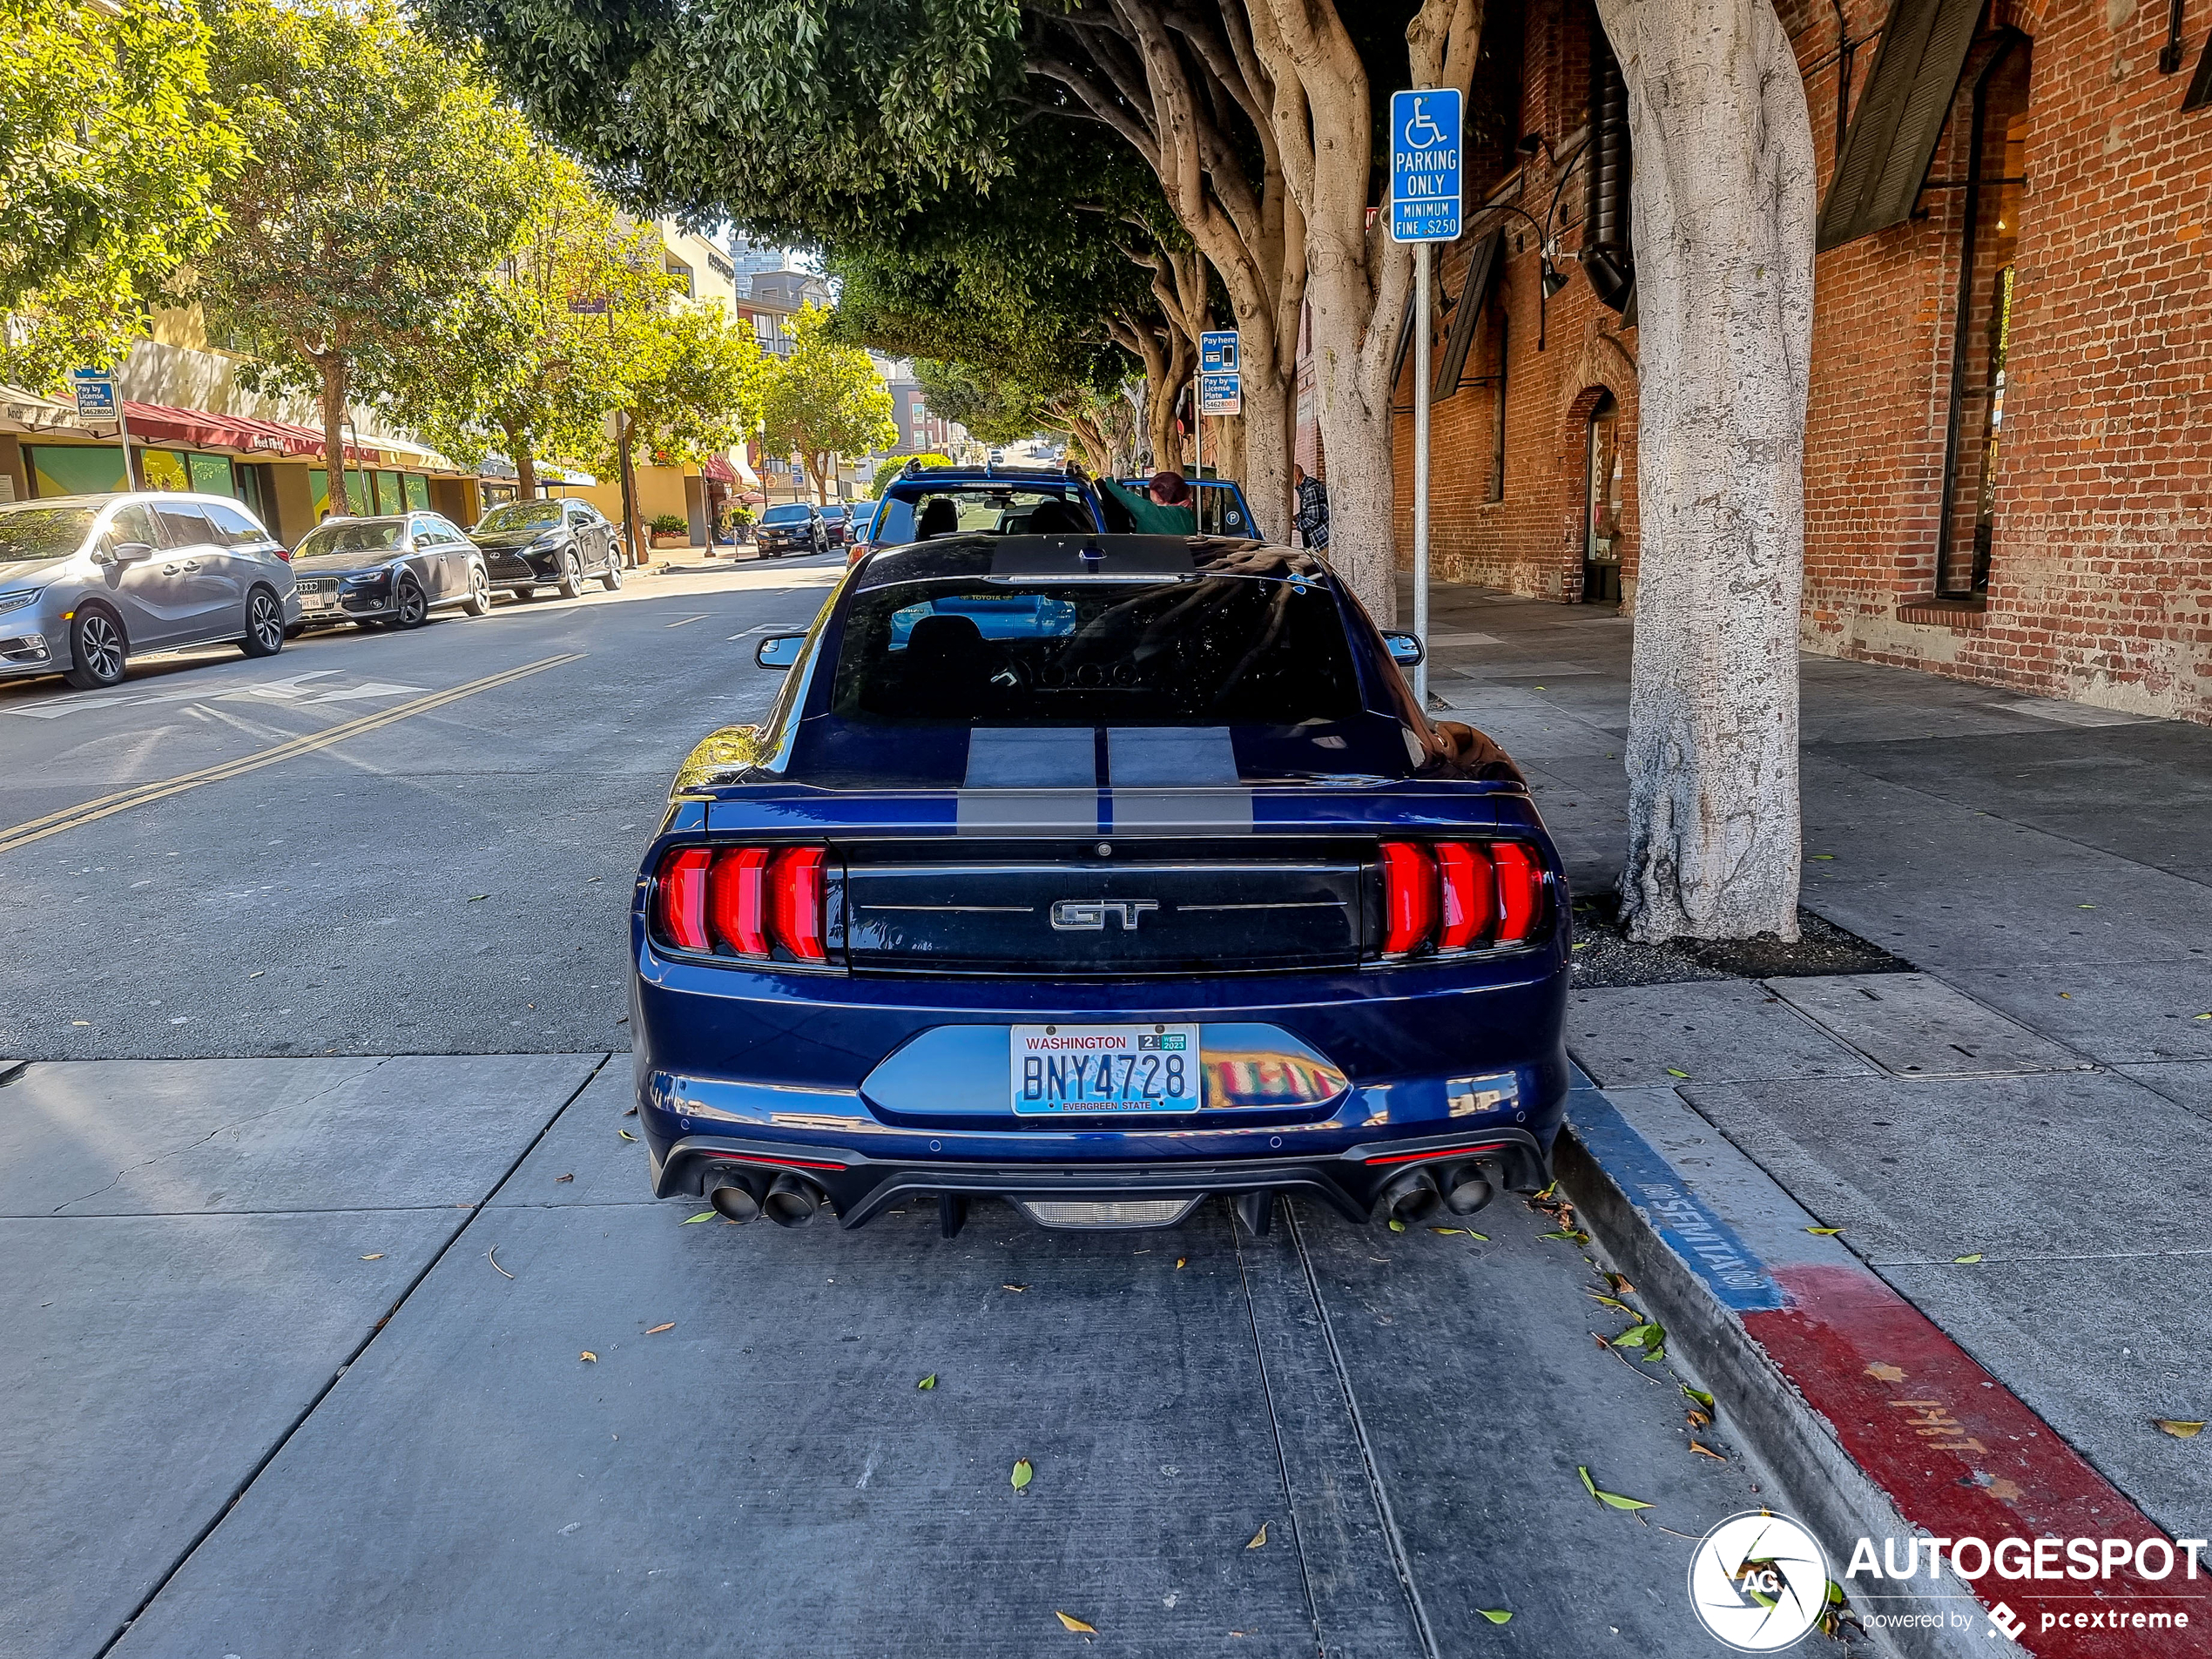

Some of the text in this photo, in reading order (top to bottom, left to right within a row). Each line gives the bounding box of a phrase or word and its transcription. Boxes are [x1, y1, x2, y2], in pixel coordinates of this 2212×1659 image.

[1396, 149, 1457, 173] PARKING
[1407, 174, 1446, 196] ONLY
[1403, 202, 1449, 218] MINIMUM
[1396, 219, 1457, 236] FINE $250
[1204, 335, 1236, 346] Pay here
[78, 385, 101, 394] Pay by
[1050, 899, 1160, 931] GT
[1026, 1036, 1126, 1050] WASHINGTON
[1143, 1035, 1154, 1048] 2
[1023, 1053, 1185, 1101] BNY4728
[1062, 1101, 1151, 1111] EVERGREEN STATE
